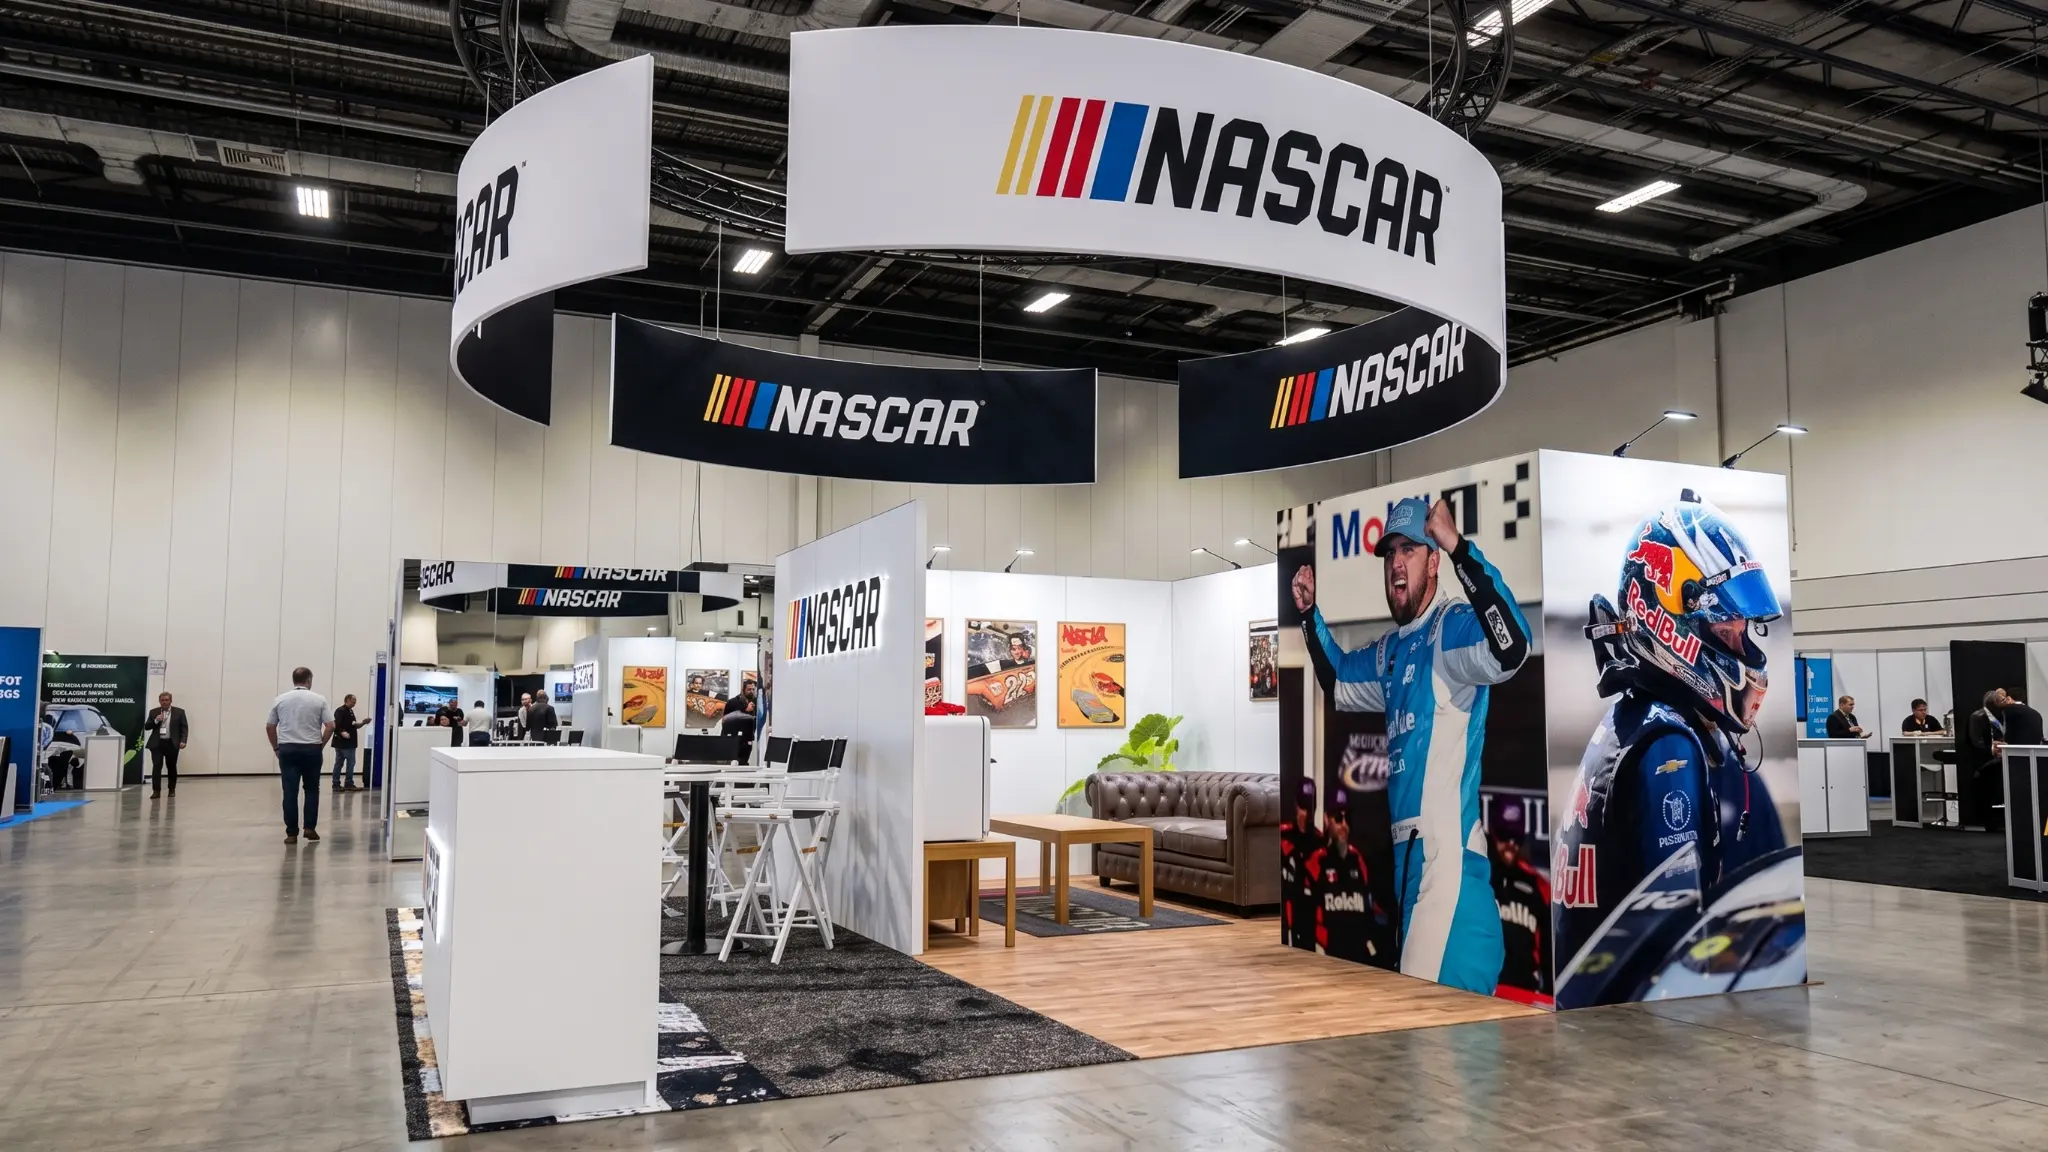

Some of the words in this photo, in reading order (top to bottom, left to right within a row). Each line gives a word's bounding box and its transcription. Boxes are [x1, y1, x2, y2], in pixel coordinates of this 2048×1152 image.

[1135, 107, 1443, 265] NASCAR
[1328, 322, 1465, 418] NASCAR
[769, 385, 978, 446] NASCAR
[542, 590, 622, 608] NASCAR
[804, 576, 881, 658] NASCAR
[1628, 579, 1663, 635] Red
[1657, 613, 1702, 667] Bull
[1553, 844, 1598, 908] Bull
